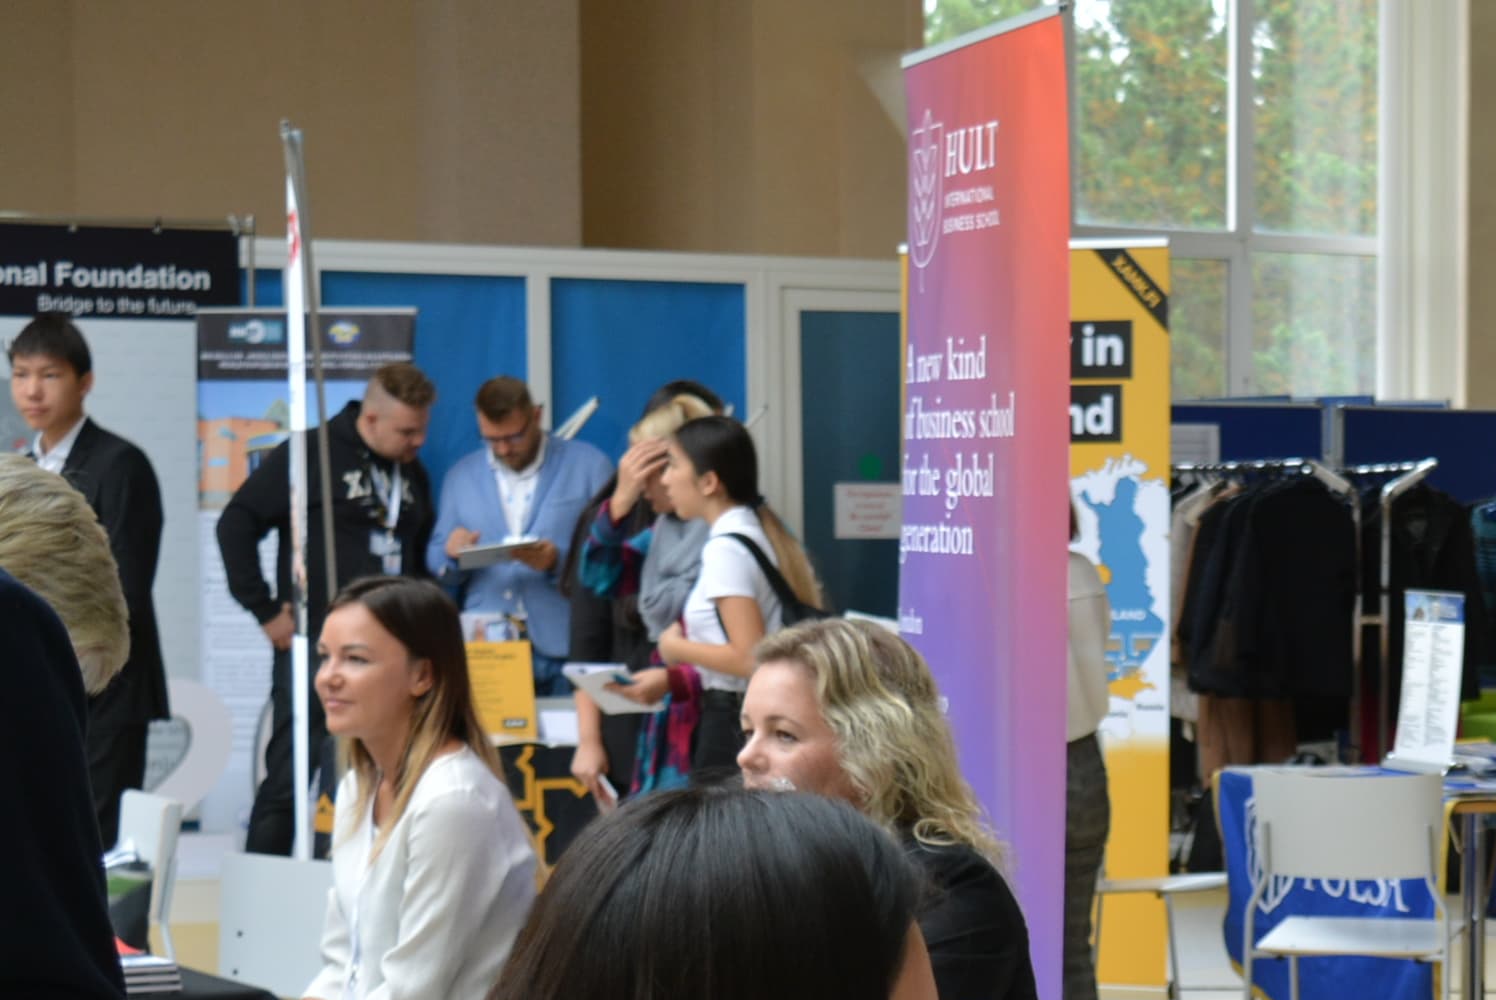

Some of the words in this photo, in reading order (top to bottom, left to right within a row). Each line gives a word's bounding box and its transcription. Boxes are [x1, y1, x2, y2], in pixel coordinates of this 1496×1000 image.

[944, 120, 999, 178] HULT
[54, 261, 212, 291] Foundation
[37, 294, 94, 316] Bridge
[96, 298, 115, 313] to
[117, 298, 145, 314] the
[148, 299, 197, 314] future
[916, 353, 943, 383] new
[946, 335, 987, 381] kind
[1081, 322, 1126, 367] in
[916, 396, 977, 440] business
[978, 391, 1015, 438] school
[919, 453, 941, 496] the
[945, 452, 994, 510] global
[899, 511, 973, 564] generation
